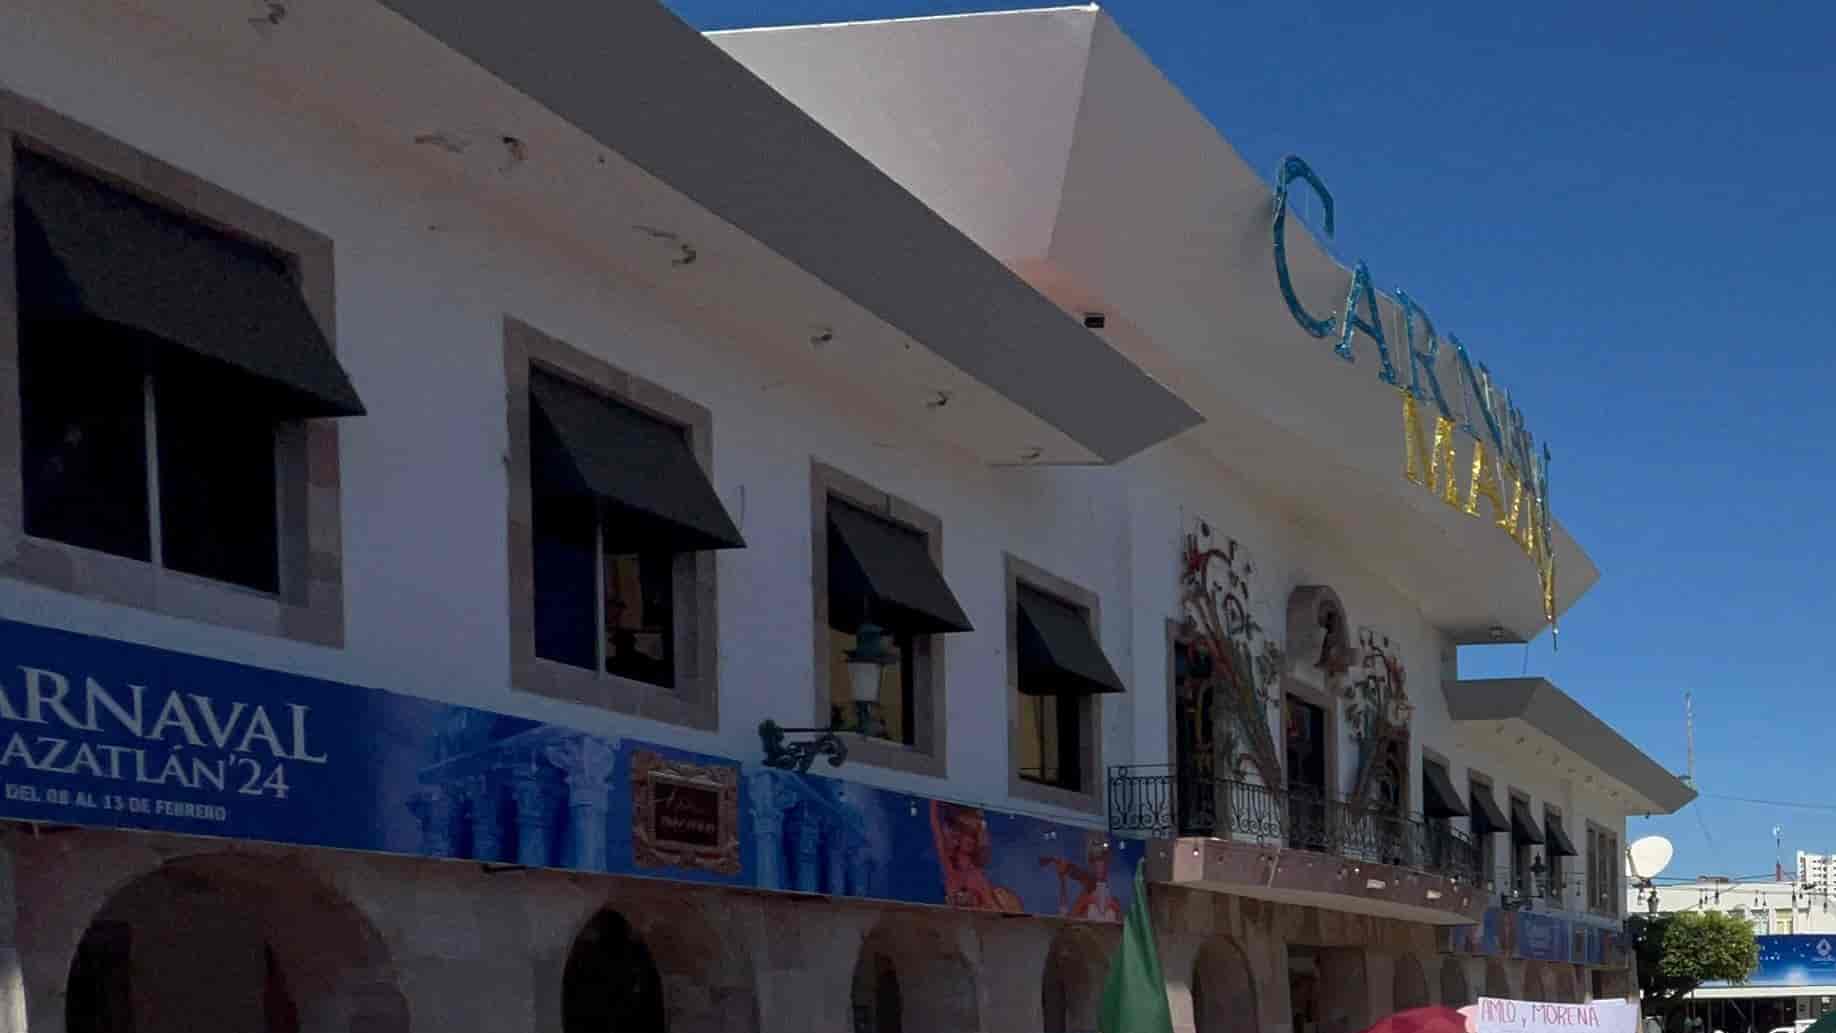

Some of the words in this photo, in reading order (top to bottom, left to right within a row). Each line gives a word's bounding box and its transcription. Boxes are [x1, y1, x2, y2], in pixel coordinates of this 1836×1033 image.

[5, 783, 40, 801] DEL
[75, 792, 97, 807] AL
[103, 796, 122, 810] 13
[128, 798, 150, 813] DE
[155, 800, 226, 821] FEBRERO
[1532, 1003, 1600, 1027] MORENA
